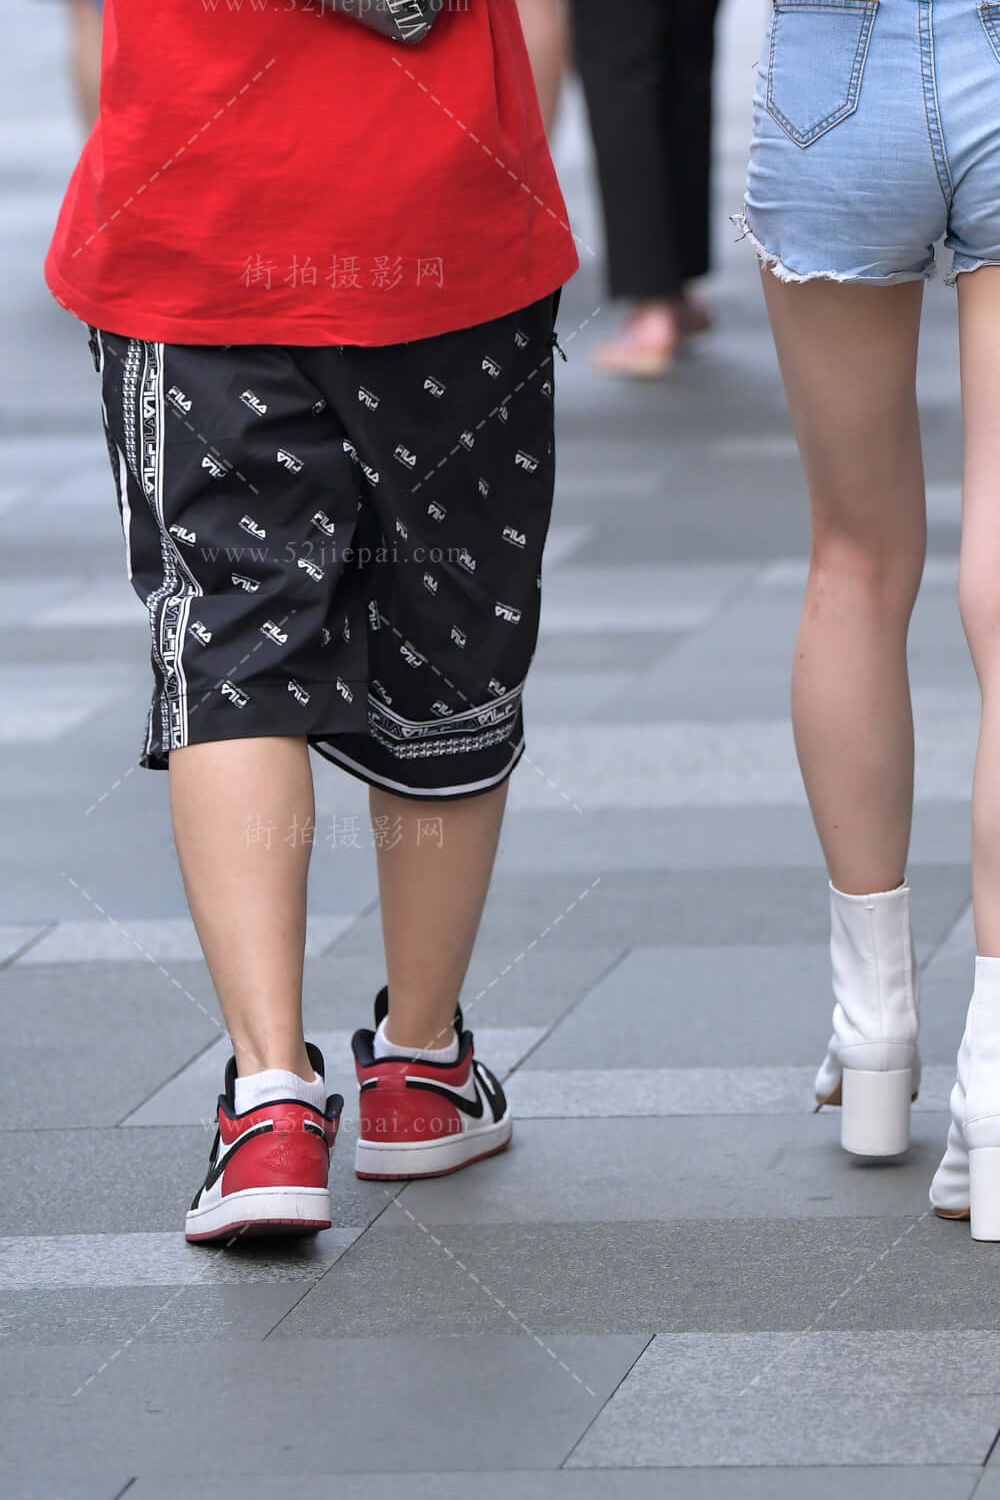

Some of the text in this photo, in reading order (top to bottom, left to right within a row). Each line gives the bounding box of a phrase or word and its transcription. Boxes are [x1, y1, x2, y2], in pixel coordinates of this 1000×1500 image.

[168, 386, 192, 412] FILA
[423, 378, 445, 398] FILA
[242, 390, 267, 414] FILA
[358, 390, 379, 412] FILA
[277, 451, 302, 474] FILA
[395, 444, 417, 466] FILA
[169, 524, 196, 544] FILA
[240, 515, 266, 539] FILA
[312, 510, 336, 535] FILA
[502, 526, 526, 545] FILA
[297, 559, 324, 582] FILA
[495, 605, 521, 625] FILA
[262, 620, 288, 644] FILA
[221, 683, 248, 708] FILA
[288, 681, 310, 707] FILA
